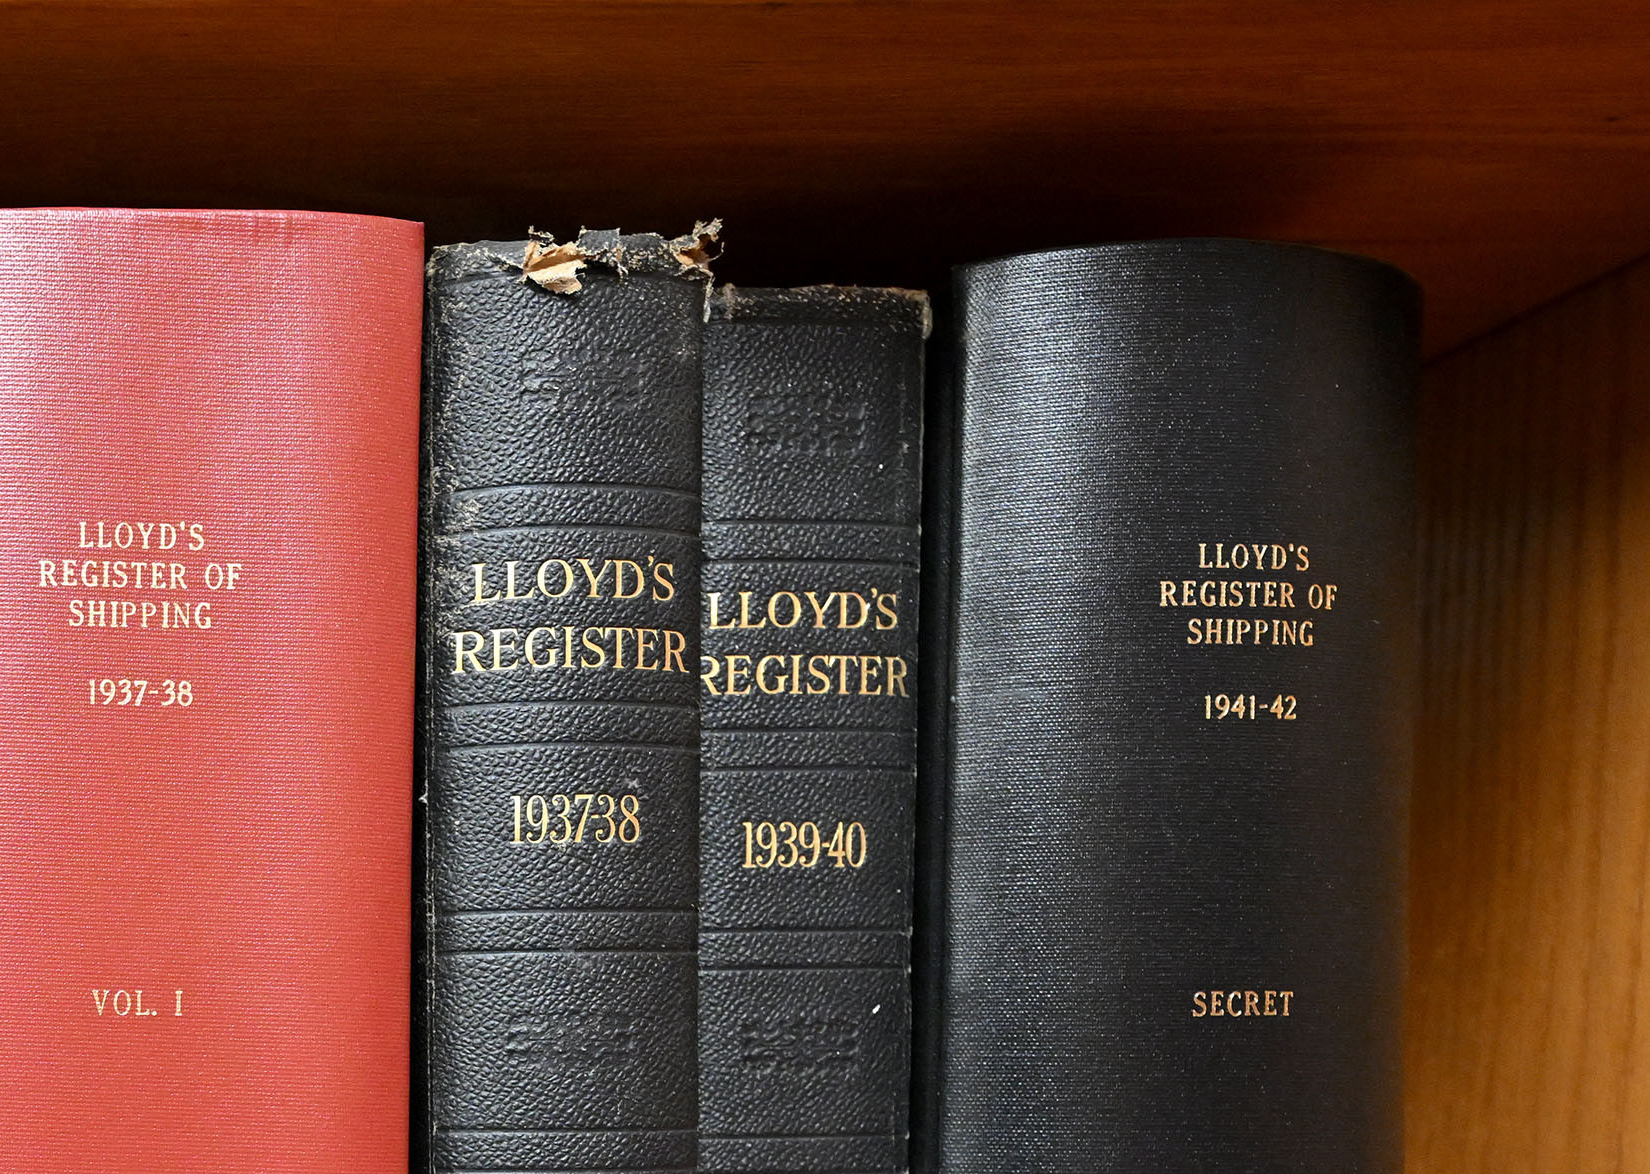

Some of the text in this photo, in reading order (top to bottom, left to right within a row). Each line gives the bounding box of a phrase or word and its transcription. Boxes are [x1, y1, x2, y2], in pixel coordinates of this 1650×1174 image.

[78, 520, 206, 552] LLOYD'S
[1196, 543, 1309, 573] LLOYD'S
[38, 560, 244, 593] REGISTER OF
[468, 553, 677, 607] LLOYD'S
[705, 586, 899, 631] LLOYD'S
[1159, 580, 1338, 610] REGISTER OF
[67, 599, 213, 631] SHIPPING
[1186, 617, 1315, 648] SHIPPING
[450, 629, 690, 675] REGISTER
[699, 654, 911, 699] REGISTER
[87, 678, 195, 709] 1937-38
[1202, 692, 1298, 723] 1941-42
[510, 794, 642, 846] 1937-38
[741, 820, 867, 869] 1939-40
[91, 988, 184, 1018] VOL. I
[1190, 989, 1295, 1020] SECRET
